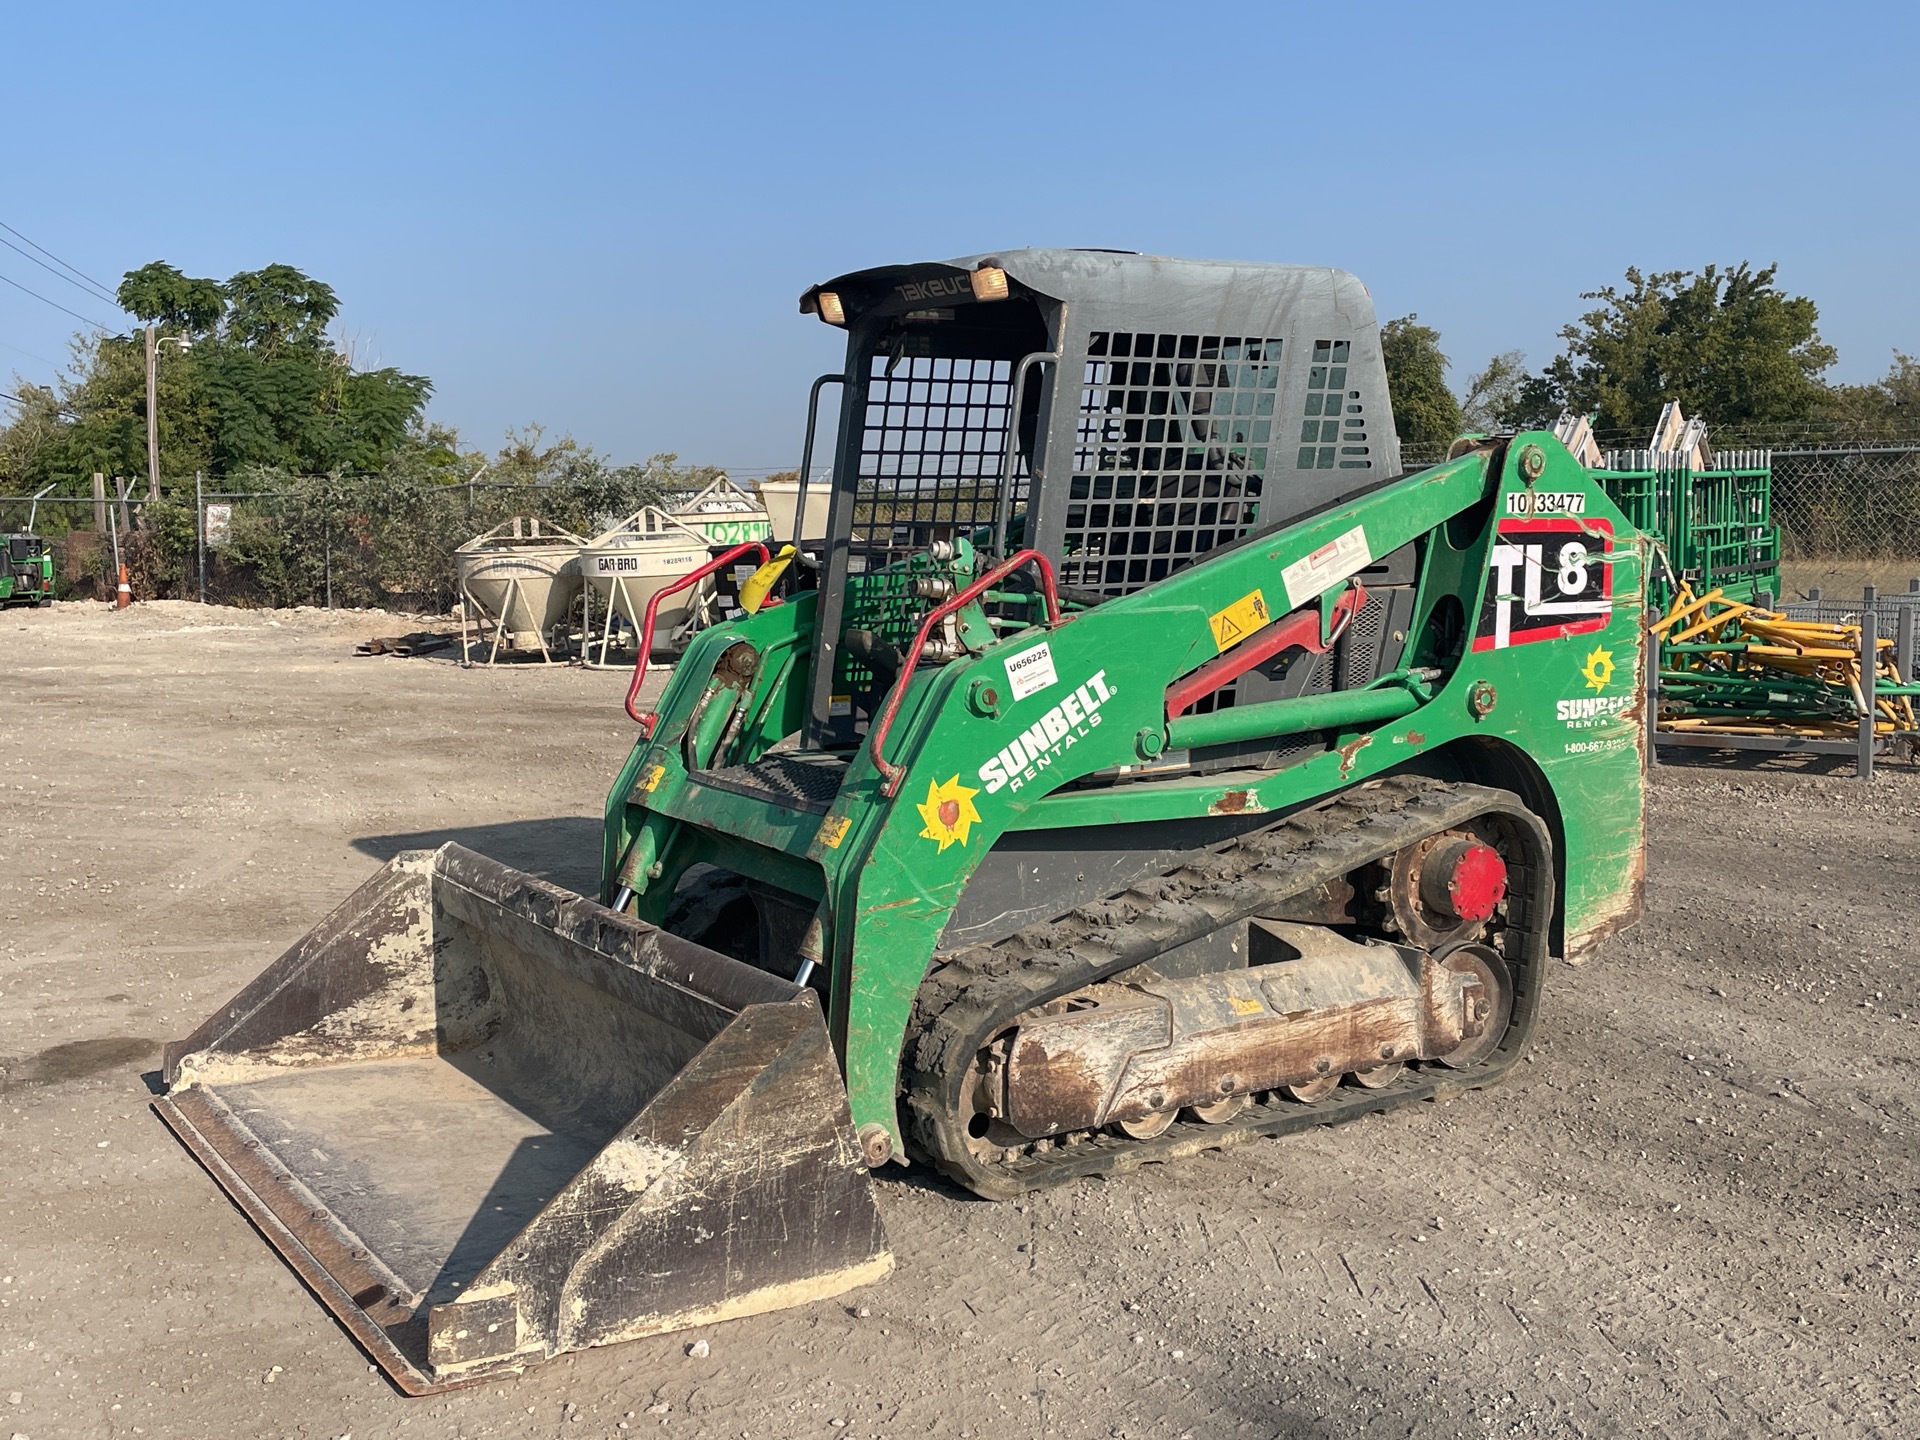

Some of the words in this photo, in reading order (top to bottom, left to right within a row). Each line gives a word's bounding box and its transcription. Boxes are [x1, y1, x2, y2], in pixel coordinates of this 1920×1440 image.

[894, 275, 971, 301] TAKEUC
[1508, 493, 1585, 513] 1033477
[598, 558, 638, 571] GAR-BRO
[1009, 648, 1048, 672] U656225
[978, 669, 1112, 794] SUNBELT
[1009, 712, 1102, 793] RENTALS
